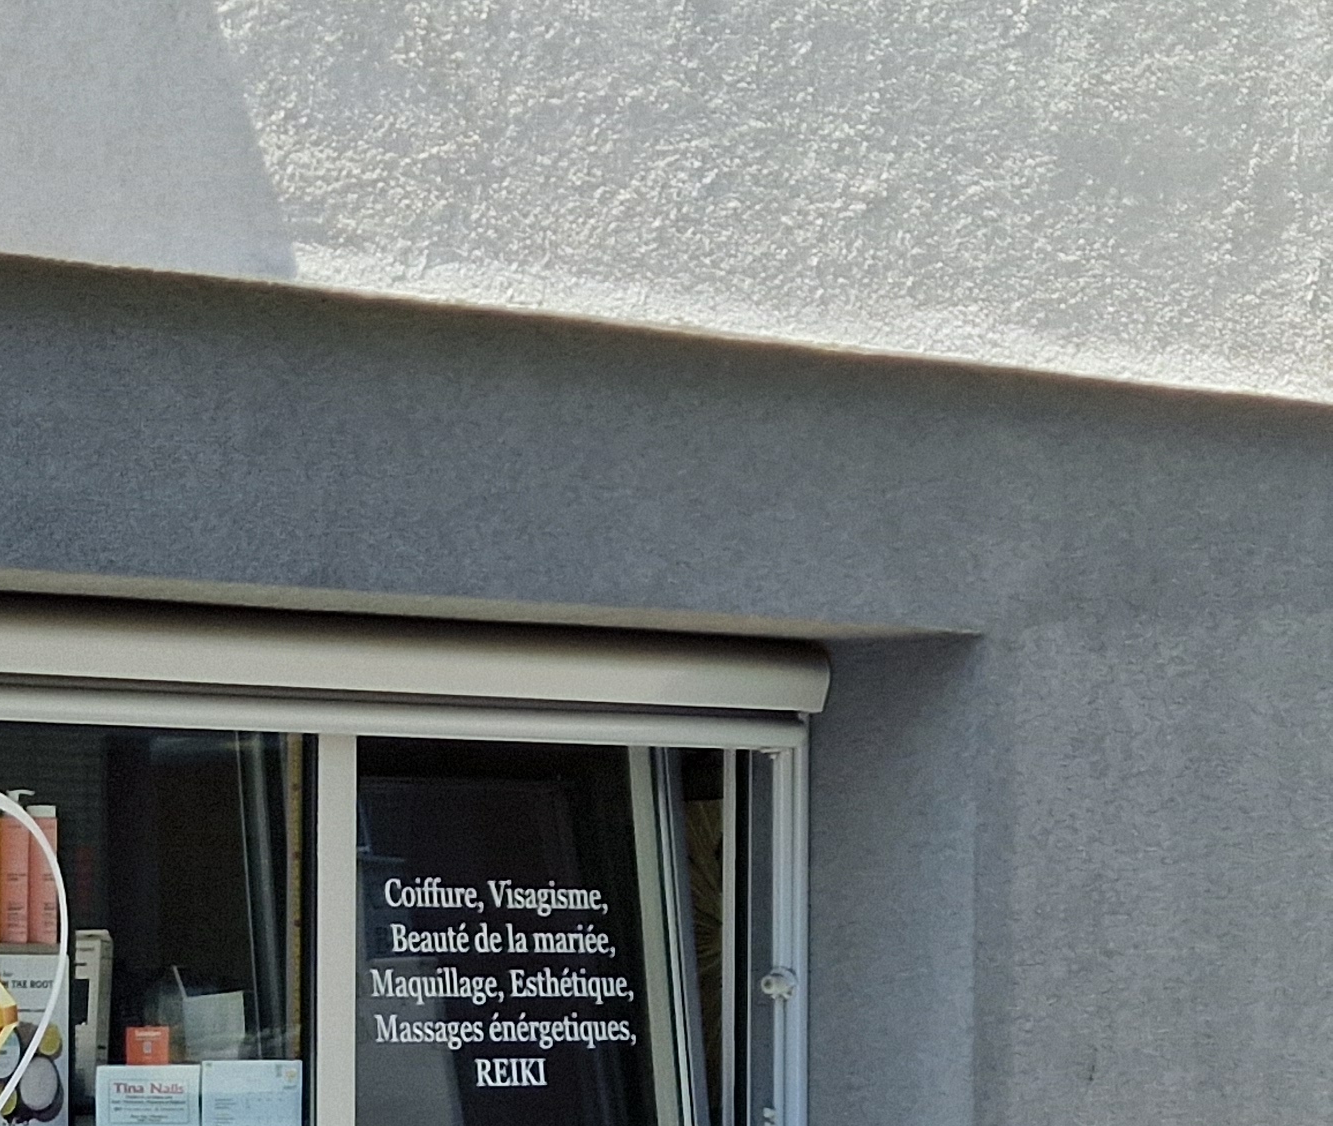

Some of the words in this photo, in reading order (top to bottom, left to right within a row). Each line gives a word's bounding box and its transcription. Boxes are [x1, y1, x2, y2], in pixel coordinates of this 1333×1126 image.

[384, 877, 484, 913] Coiffure,
[488, 879, 609, 917] Visagisme,
[390, 922, 470, 954] Beauté
[474, 924, 502, 954] de
[507, 923, 528, 954] la
[533, 924, 616, 958] mariée,
[370, 967, 505, 1004] Maquillage,
[509, 967, 634, 1005] Esthétique,
[375, 1014, 485, 1050] Massages
[490, 1012, 637, 1049] énérgetiques,
[113, 1082, 144, 1094] Tina
[150, 1083, 185, 1095] Nails
[475, 1058, 548, 1087] REIKI
